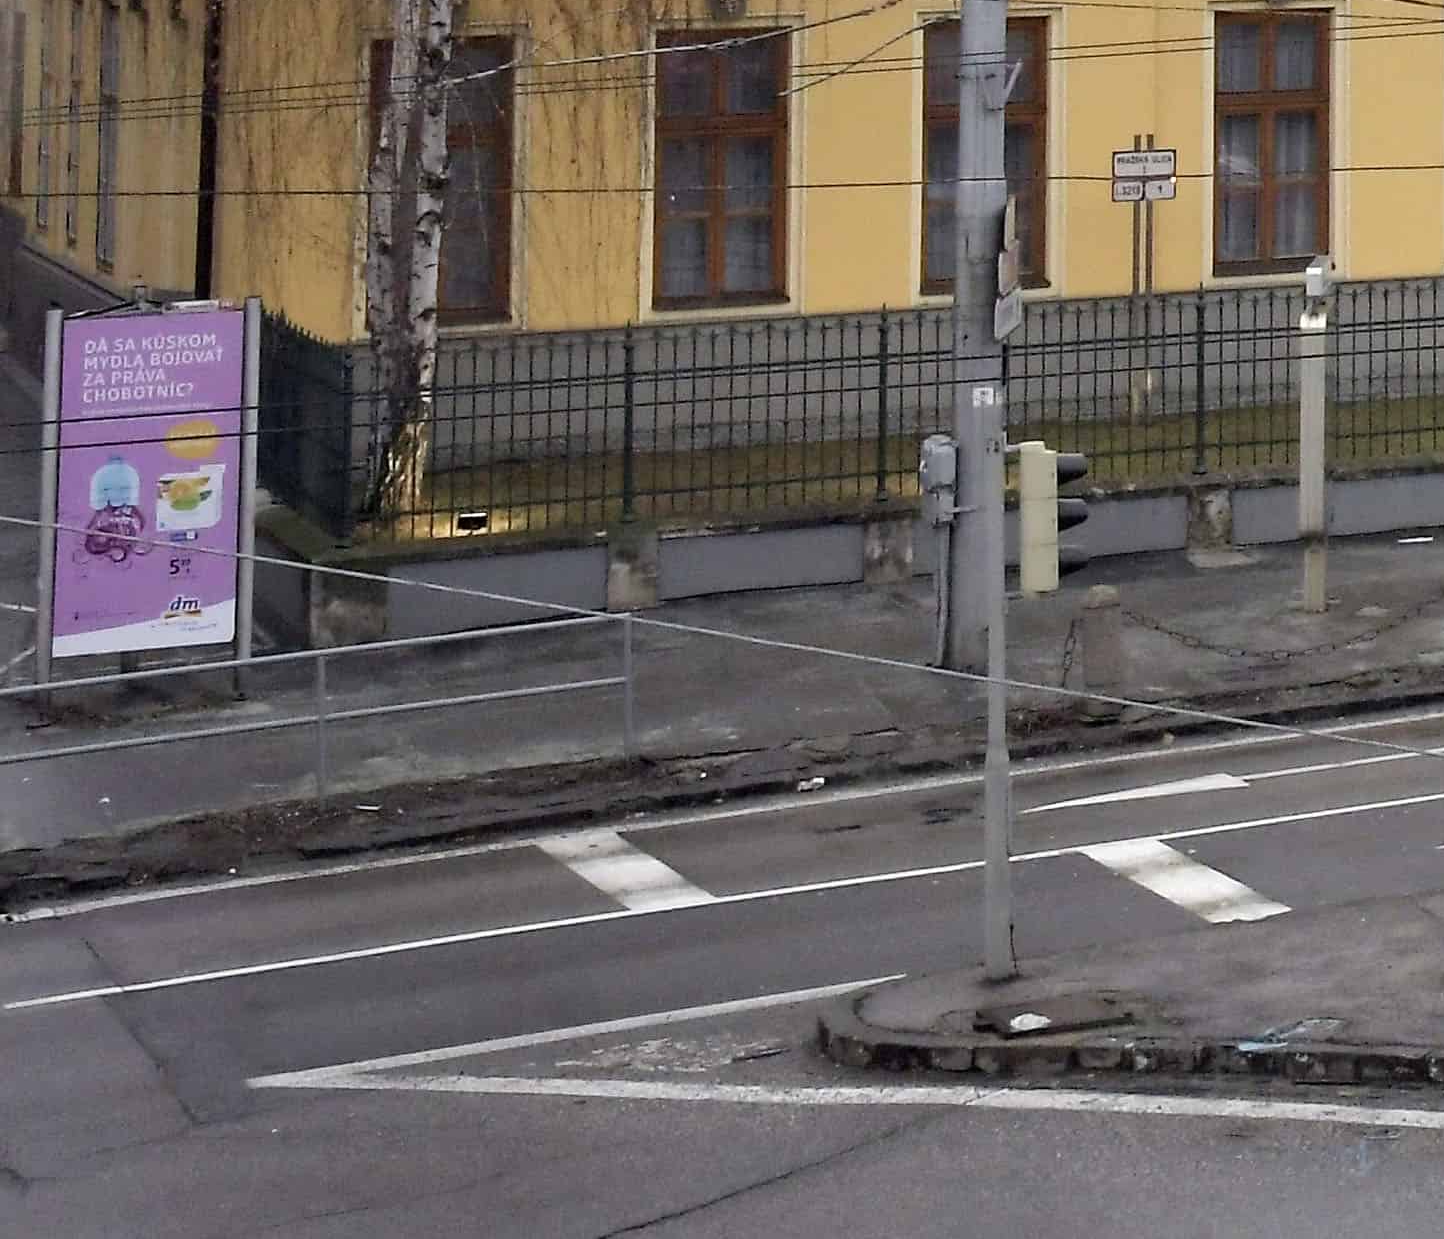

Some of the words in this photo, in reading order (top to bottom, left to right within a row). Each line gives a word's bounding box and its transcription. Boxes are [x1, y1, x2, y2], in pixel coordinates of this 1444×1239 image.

[113, 337, 136, 353] SA
[83, 371, 105, 387] ZA
[170, 596, 199, 611] dm
